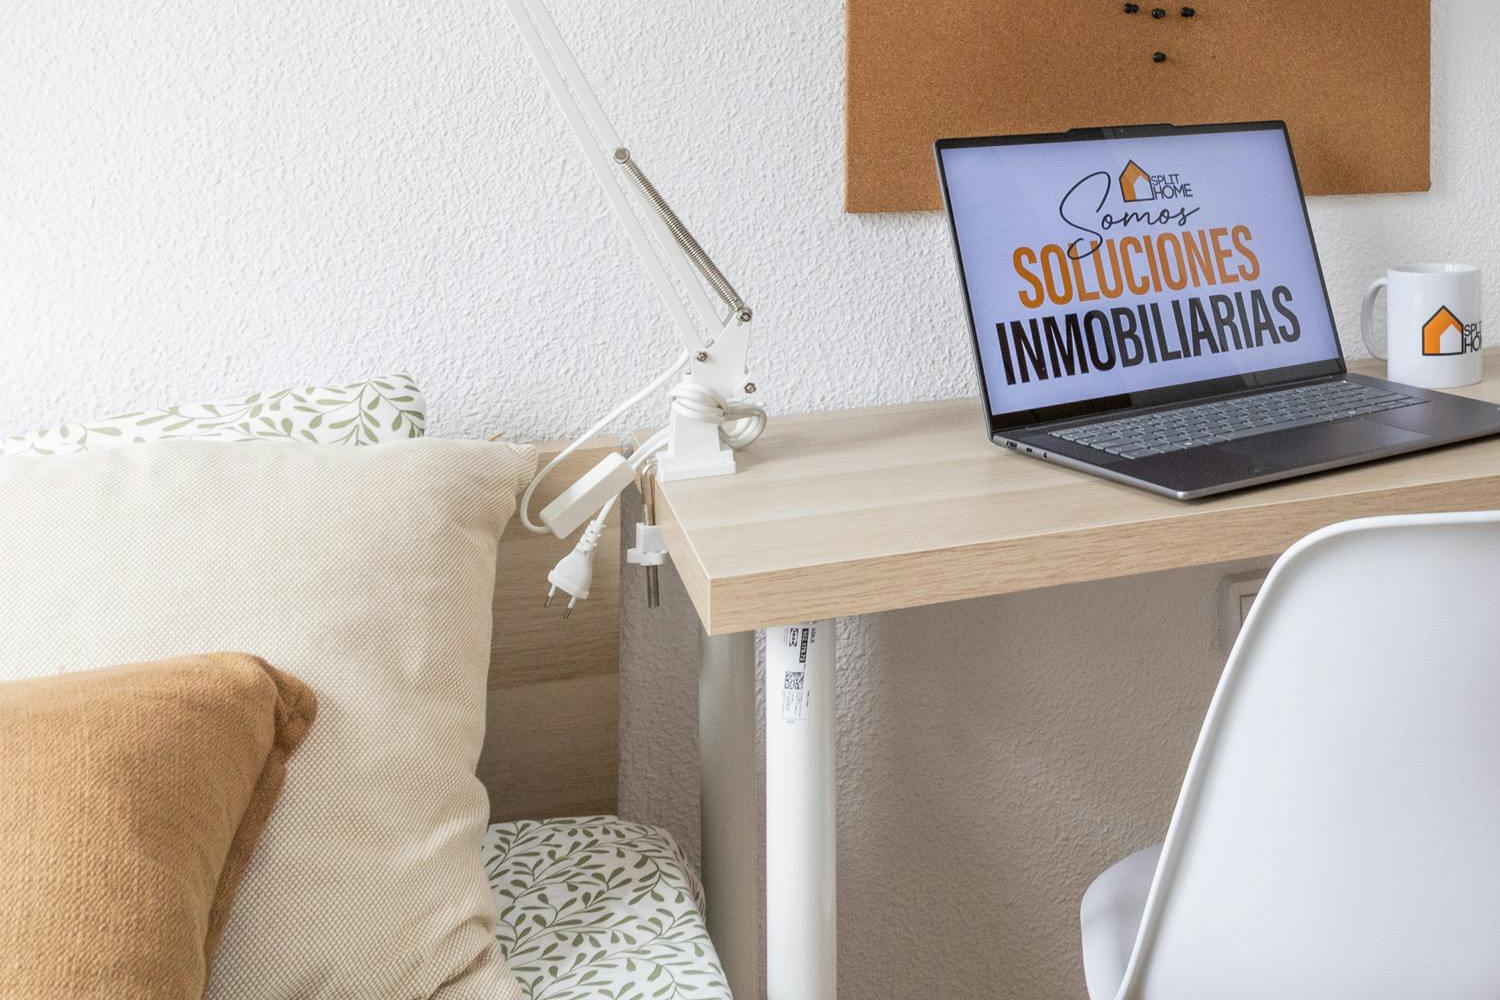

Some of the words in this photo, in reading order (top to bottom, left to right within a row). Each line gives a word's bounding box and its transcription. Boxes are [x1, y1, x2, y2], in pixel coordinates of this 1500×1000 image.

[1151, 173, 1180, 187] SPLIT
[1153, 183, 1194, 200] HOME
[1059, 170, 1201, 260] Somos
[1012, 224, 1261, 309] SOLUCIONES
[995, 285, 1301, 386] INMOBILIARIAS
[1464, 334, 1483, 354] HO
